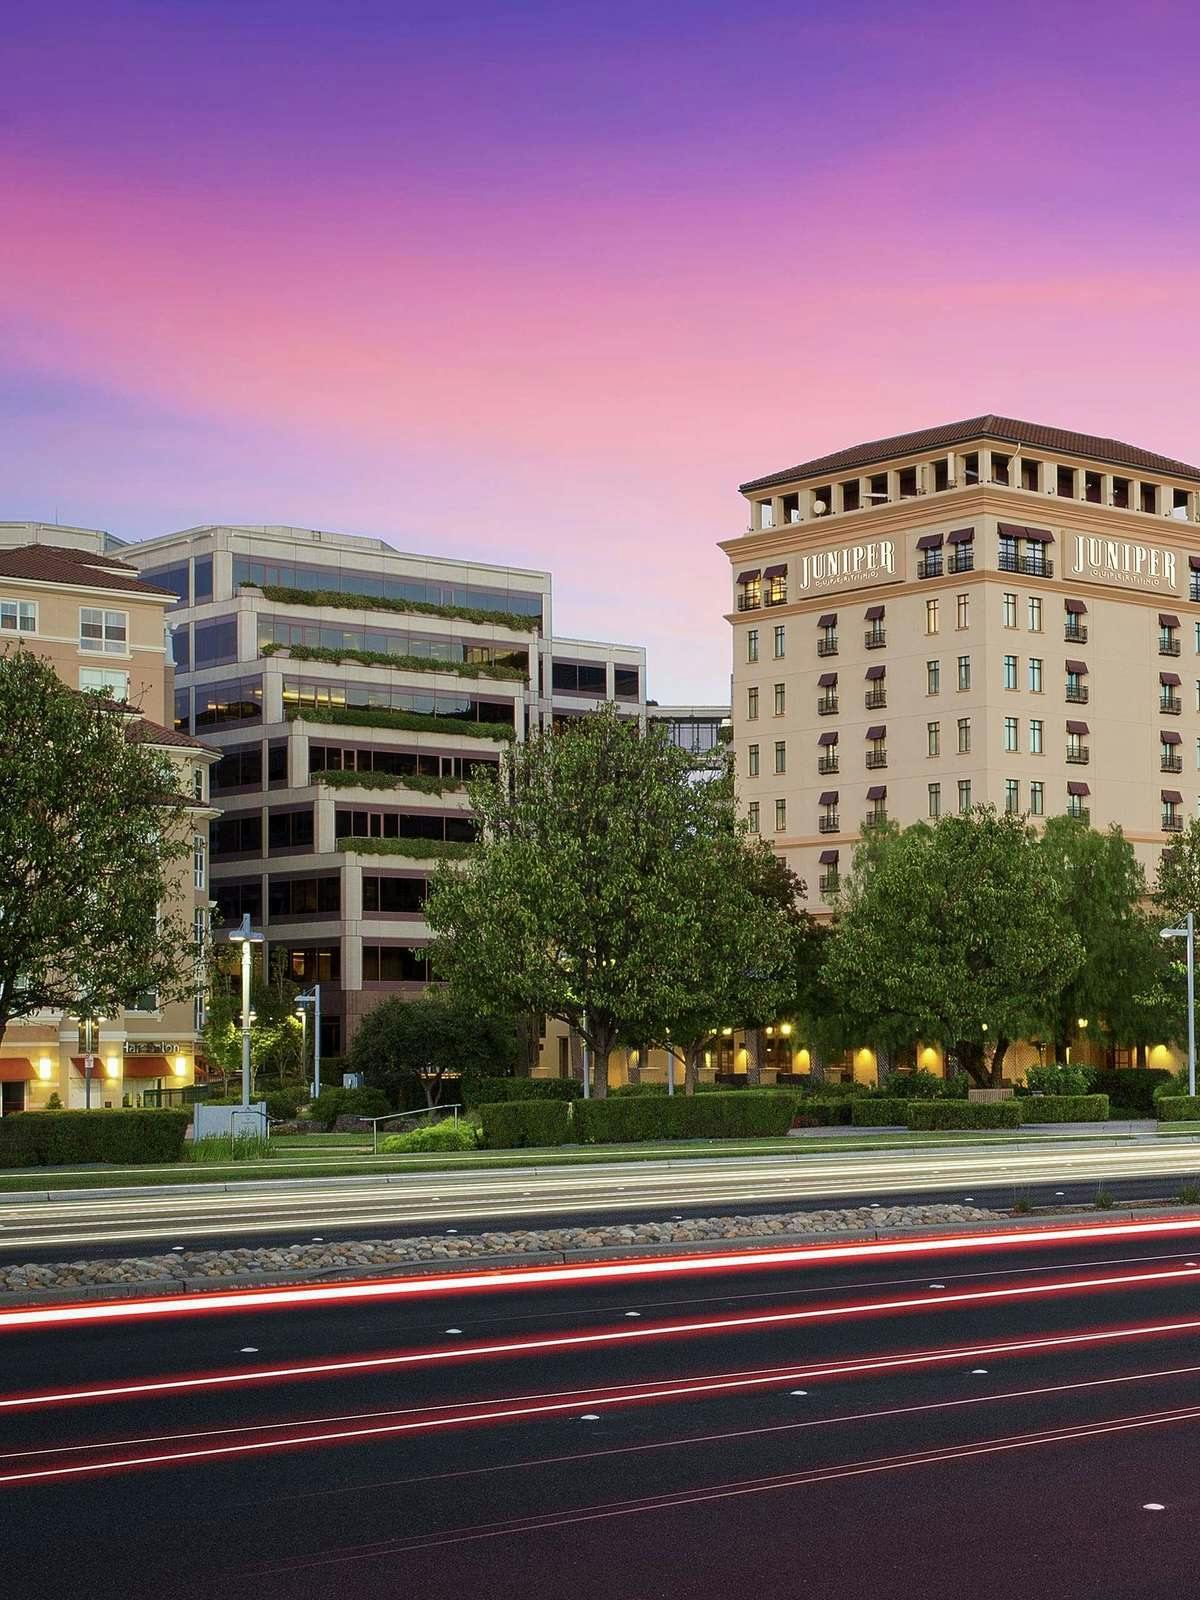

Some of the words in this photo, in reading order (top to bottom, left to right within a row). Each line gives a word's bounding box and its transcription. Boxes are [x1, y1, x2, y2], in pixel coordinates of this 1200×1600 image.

[800, 541, 896, 590] JUNIPER
[815, 570, 879, 587] CUPERTINO
[1072, 535, 1176, 591] JUNIPER
[1090, 568, 1160, 586] CUPERTINO
